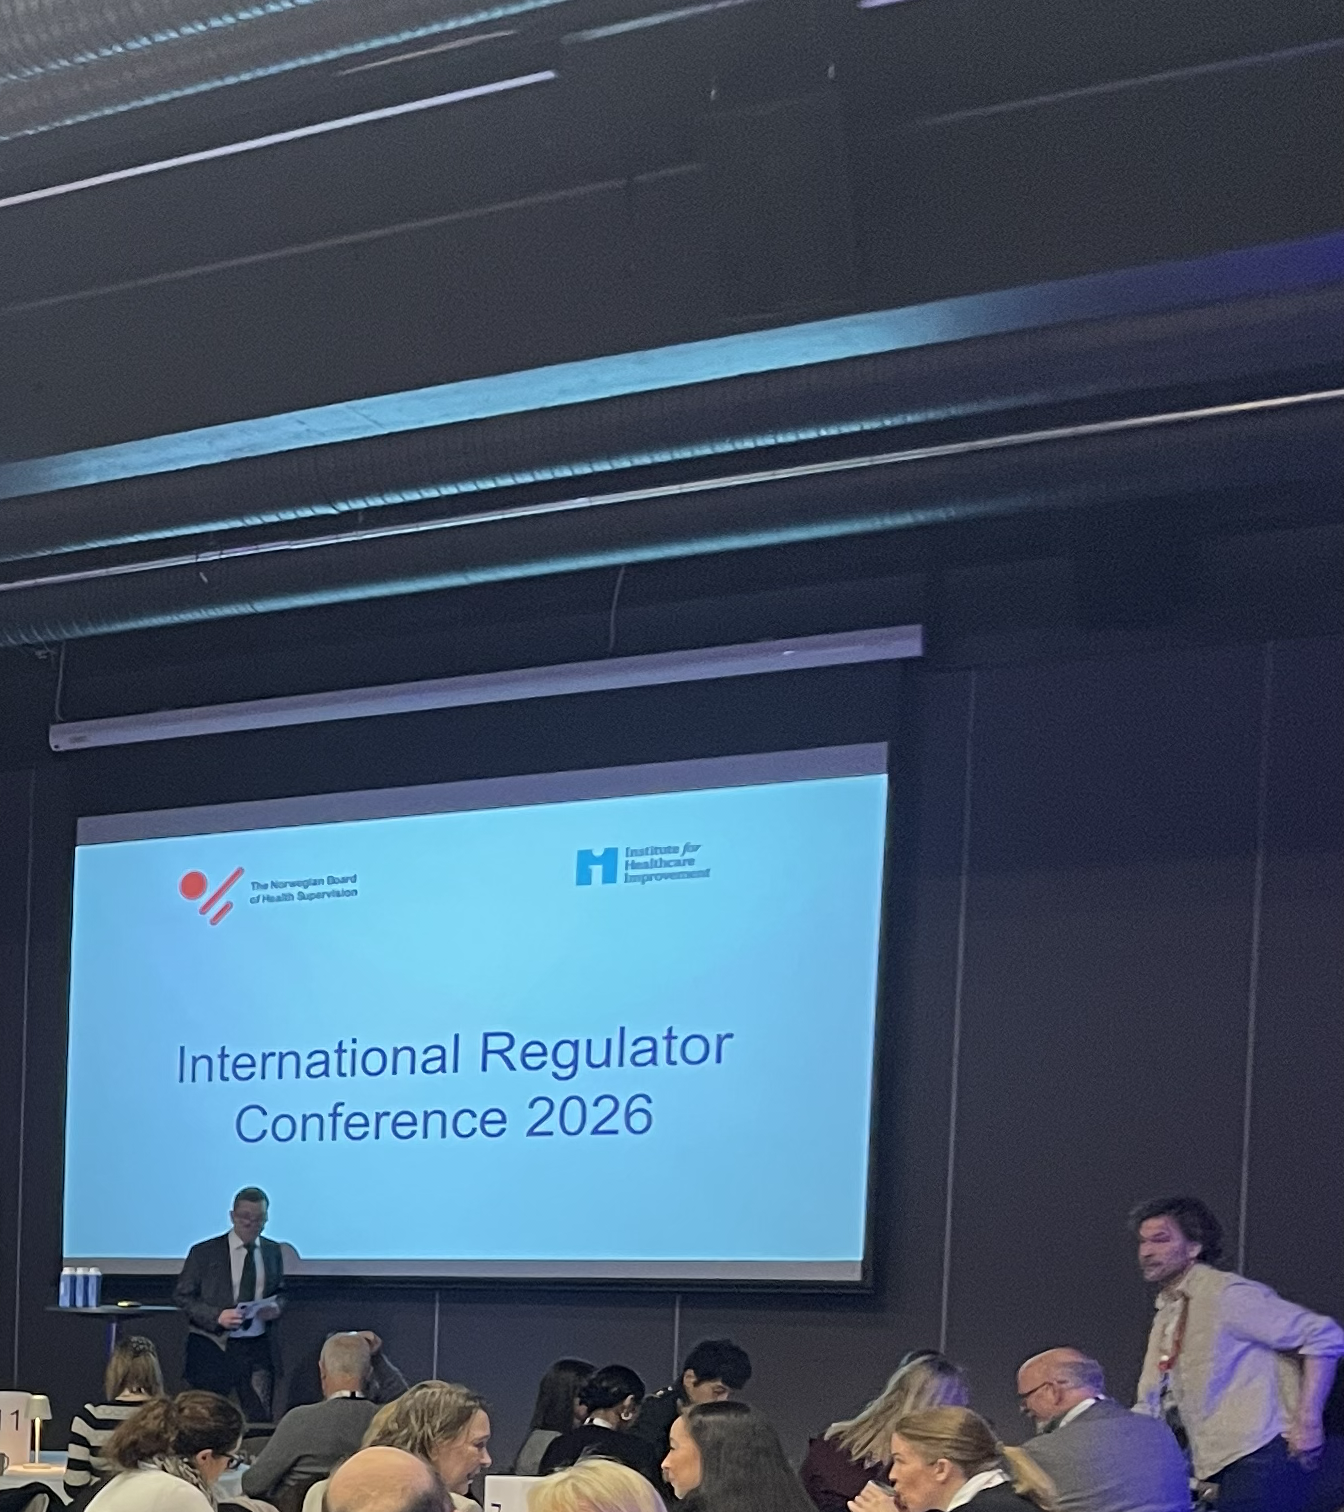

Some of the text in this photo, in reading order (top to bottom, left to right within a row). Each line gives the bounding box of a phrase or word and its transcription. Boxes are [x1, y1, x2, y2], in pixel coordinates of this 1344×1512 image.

[625, 841, 702, 857] Institute for
[625, 858, 695, 870] Healthcare
[251, 875, 357, 891] The Norwegian Board
[624, 868, 711, 885] Improvement
[250, 889, 358, 904] of Health Supervision
[178, 1025, 735, 1084] International Regulator
[235, 1092, 653, 1144] Conference 2026
